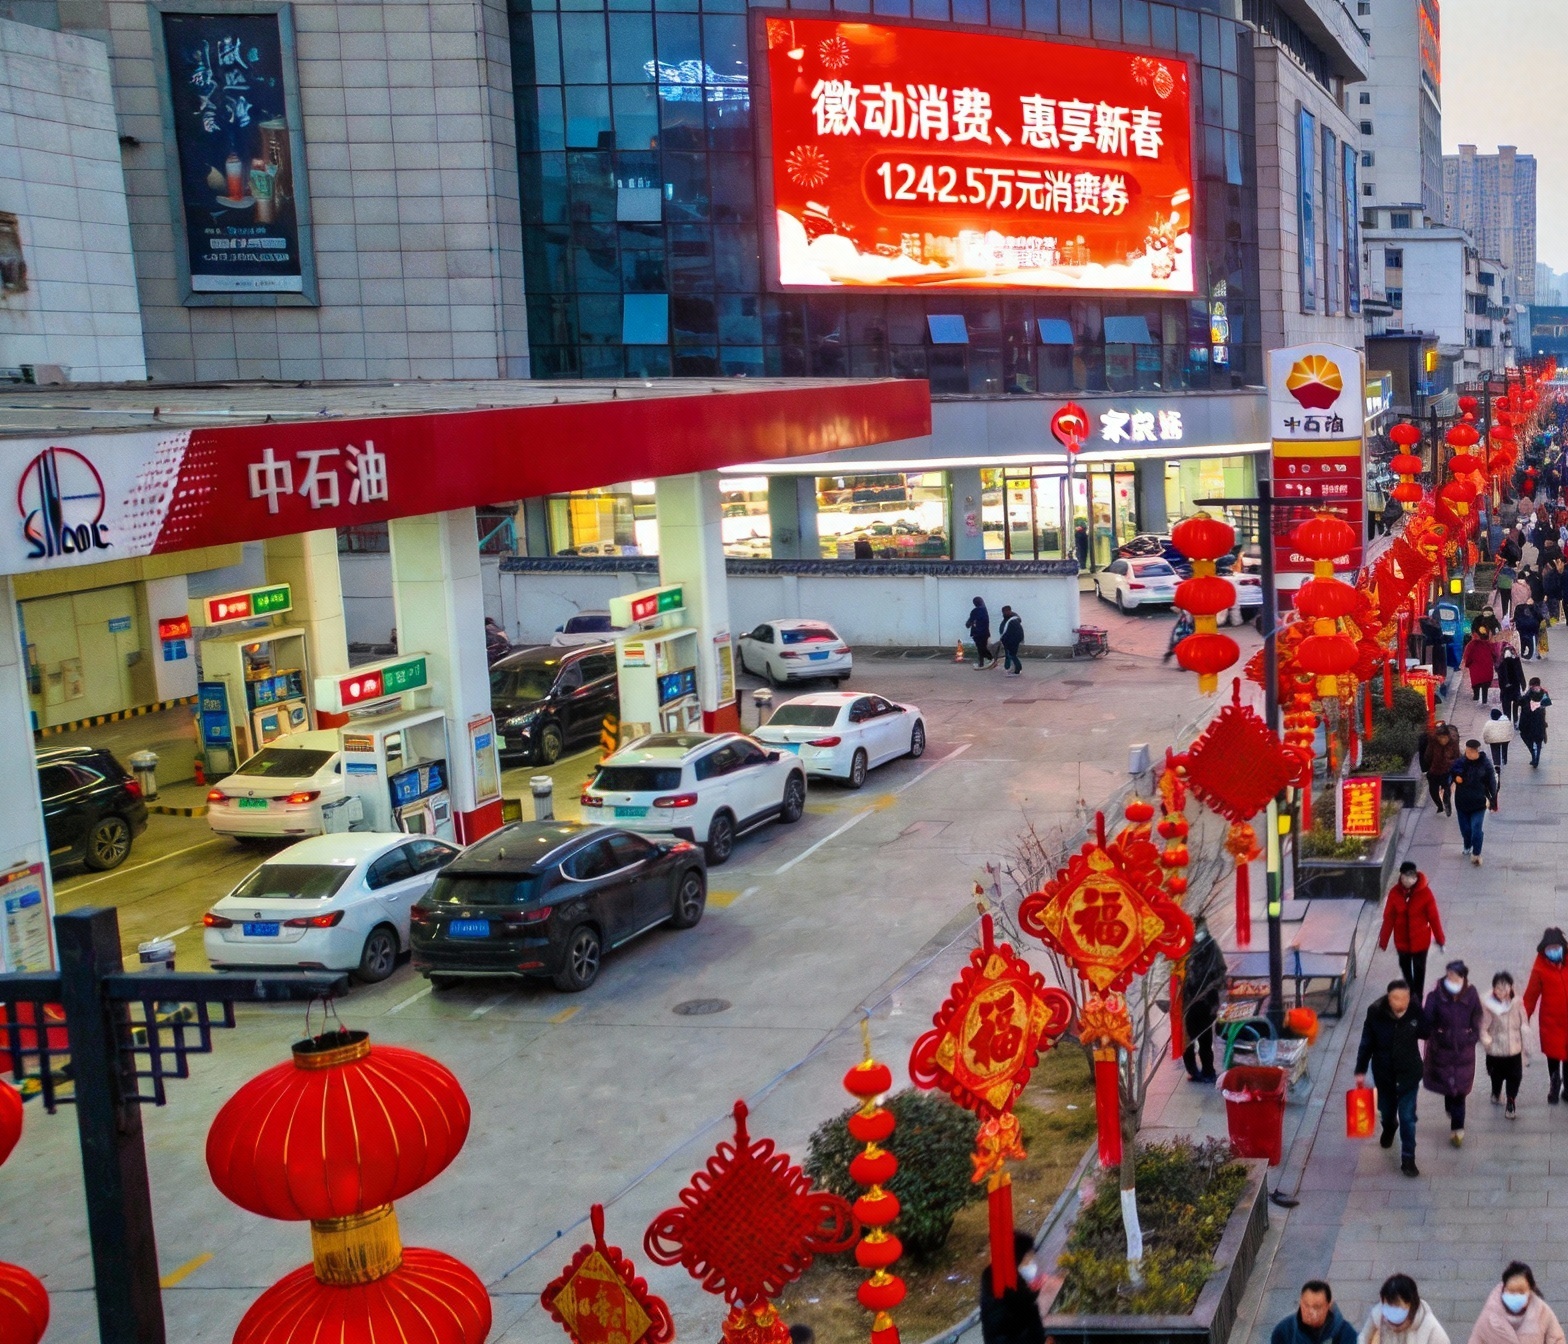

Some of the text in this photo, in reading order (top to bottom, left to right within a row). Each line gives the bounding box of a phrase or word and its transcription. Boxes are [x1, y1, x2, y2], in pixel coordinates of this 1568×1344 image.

[248, 440, 389, 514] 中石油
[1074, 887, 1129, 949] 福
[968, 990, 1023, 1071] 福
